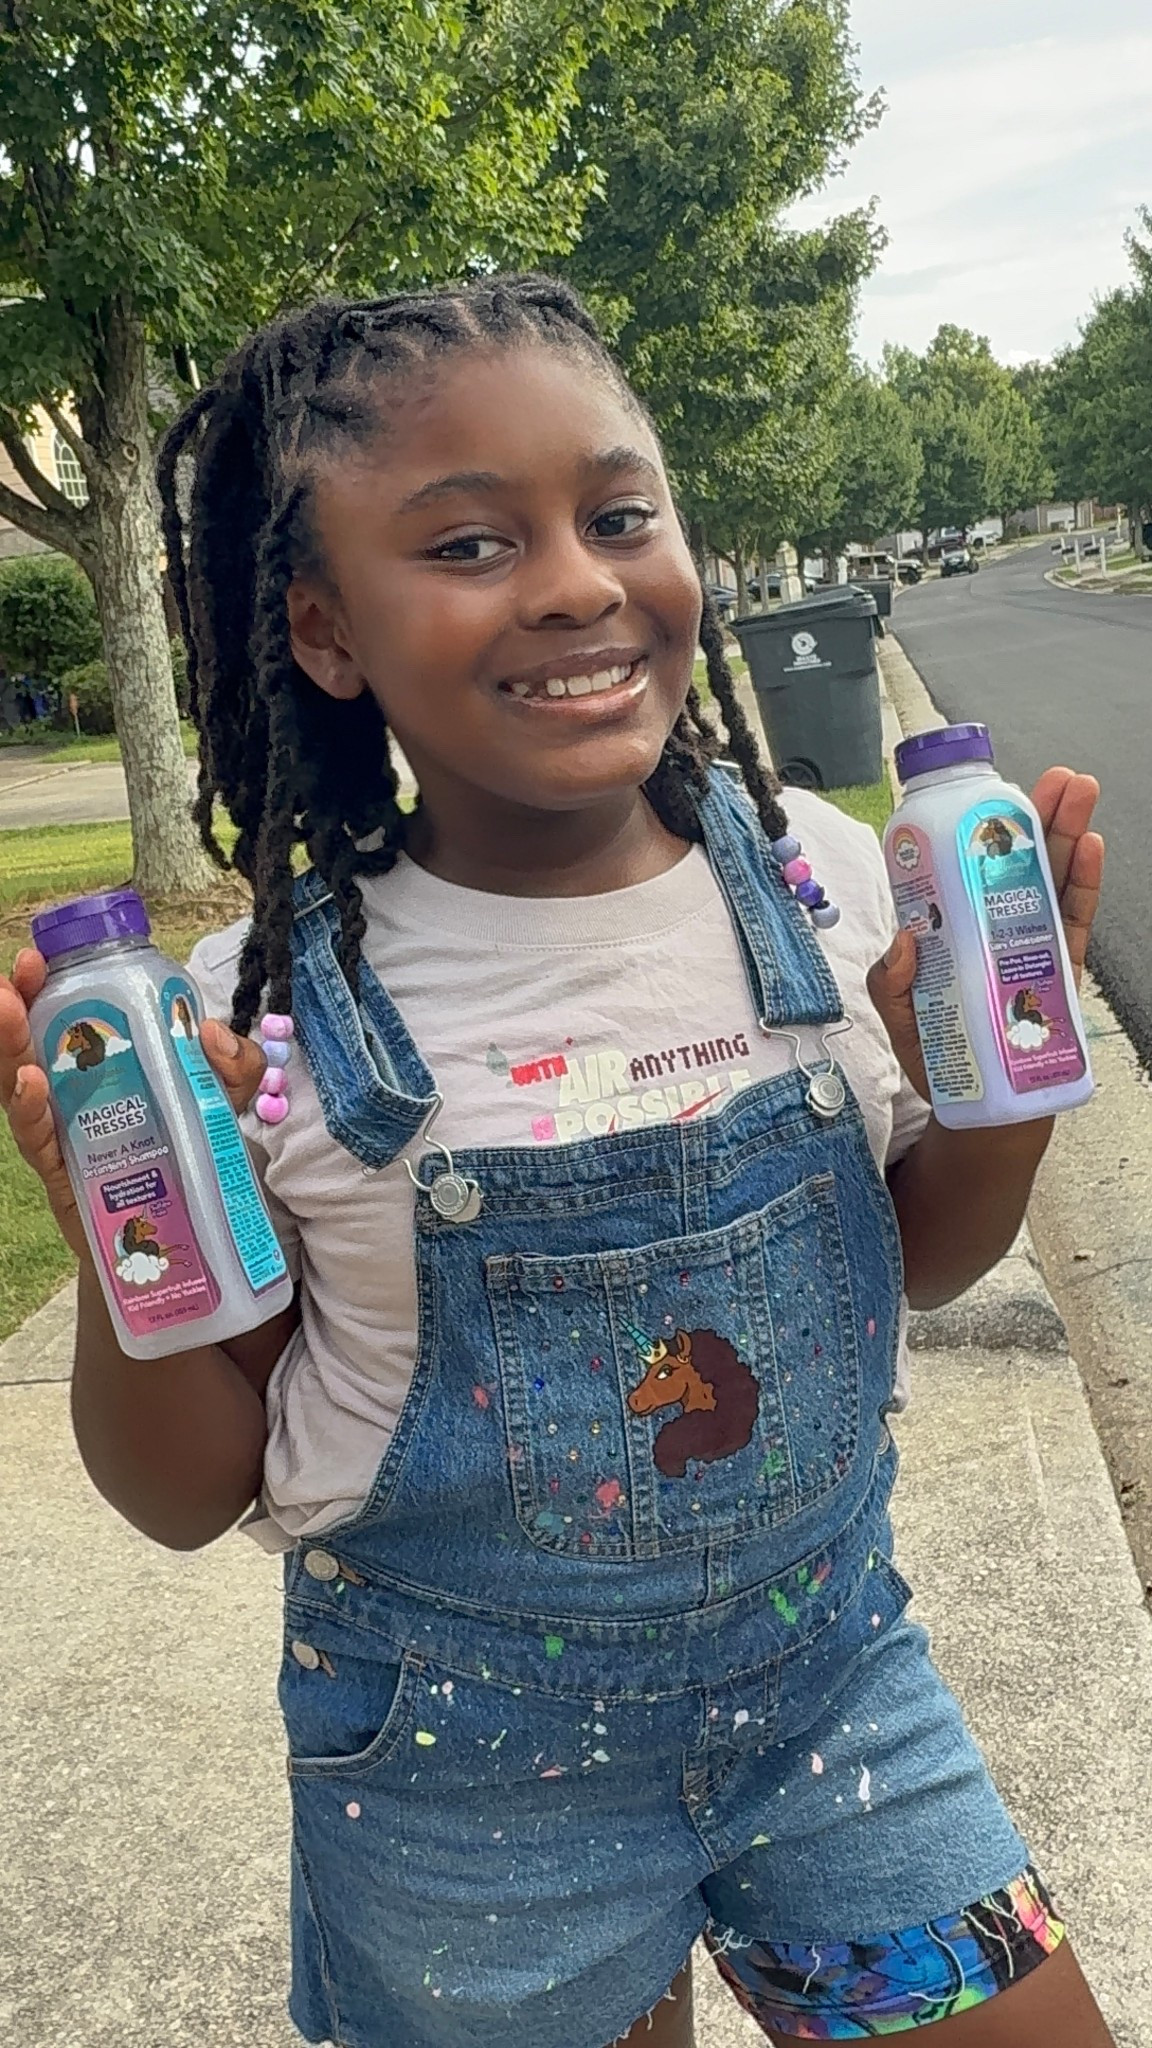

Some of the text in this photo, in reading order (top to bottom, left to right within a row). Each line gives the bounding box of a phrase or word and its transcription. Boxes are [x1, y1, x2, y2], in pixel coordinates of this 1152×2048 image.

[984, 889, 1040, 907] MAGICAL
[988, 901, 1039, 918] TRESSES
[991, 924, 1047, 939] 1-2-3 Wishes
[1009, 934, 1053, 948] Conditioner
[559, 1050, 631, 1107] AIR
[629, 1033, 750, 1082] ANYTHING
[77, 1096, 145, 1127] MAGICAL
[84, 1111, 144, 1139] TRESSES
[87, 1136, 156, 1164] Never A Knot
[83, 1146, 169, 1178] Detangling Shampoo
[103, 1174, 150, 1192] Nourishment
[108, 1182, 157, 1201] hydration for
[116, 1192, 156, 1208] all textures
[140, 1297, 164, 1309] Friendly
